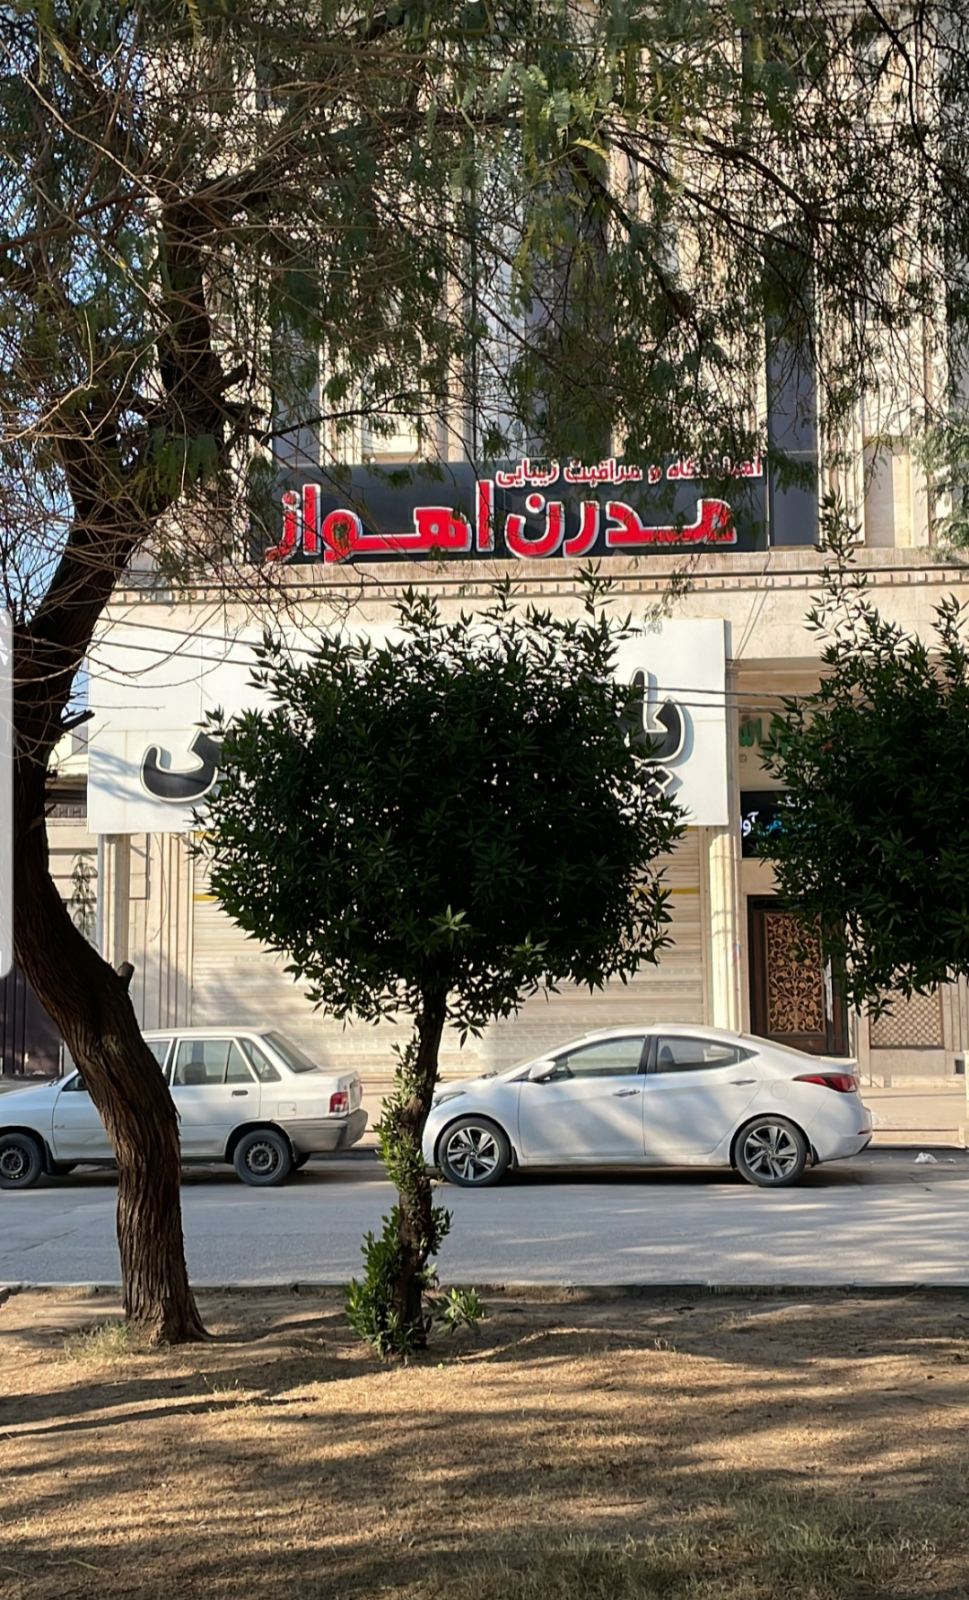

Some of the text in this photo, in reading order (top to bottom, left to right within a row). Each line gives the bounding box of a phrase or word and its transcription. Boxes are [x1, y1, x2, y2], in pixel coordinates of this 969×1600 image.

[495, 457, 560, 488] زیبایی
[564, 458, 643, 487] مراقبت
[264, 479, 738, 564] مدرن اهواز
